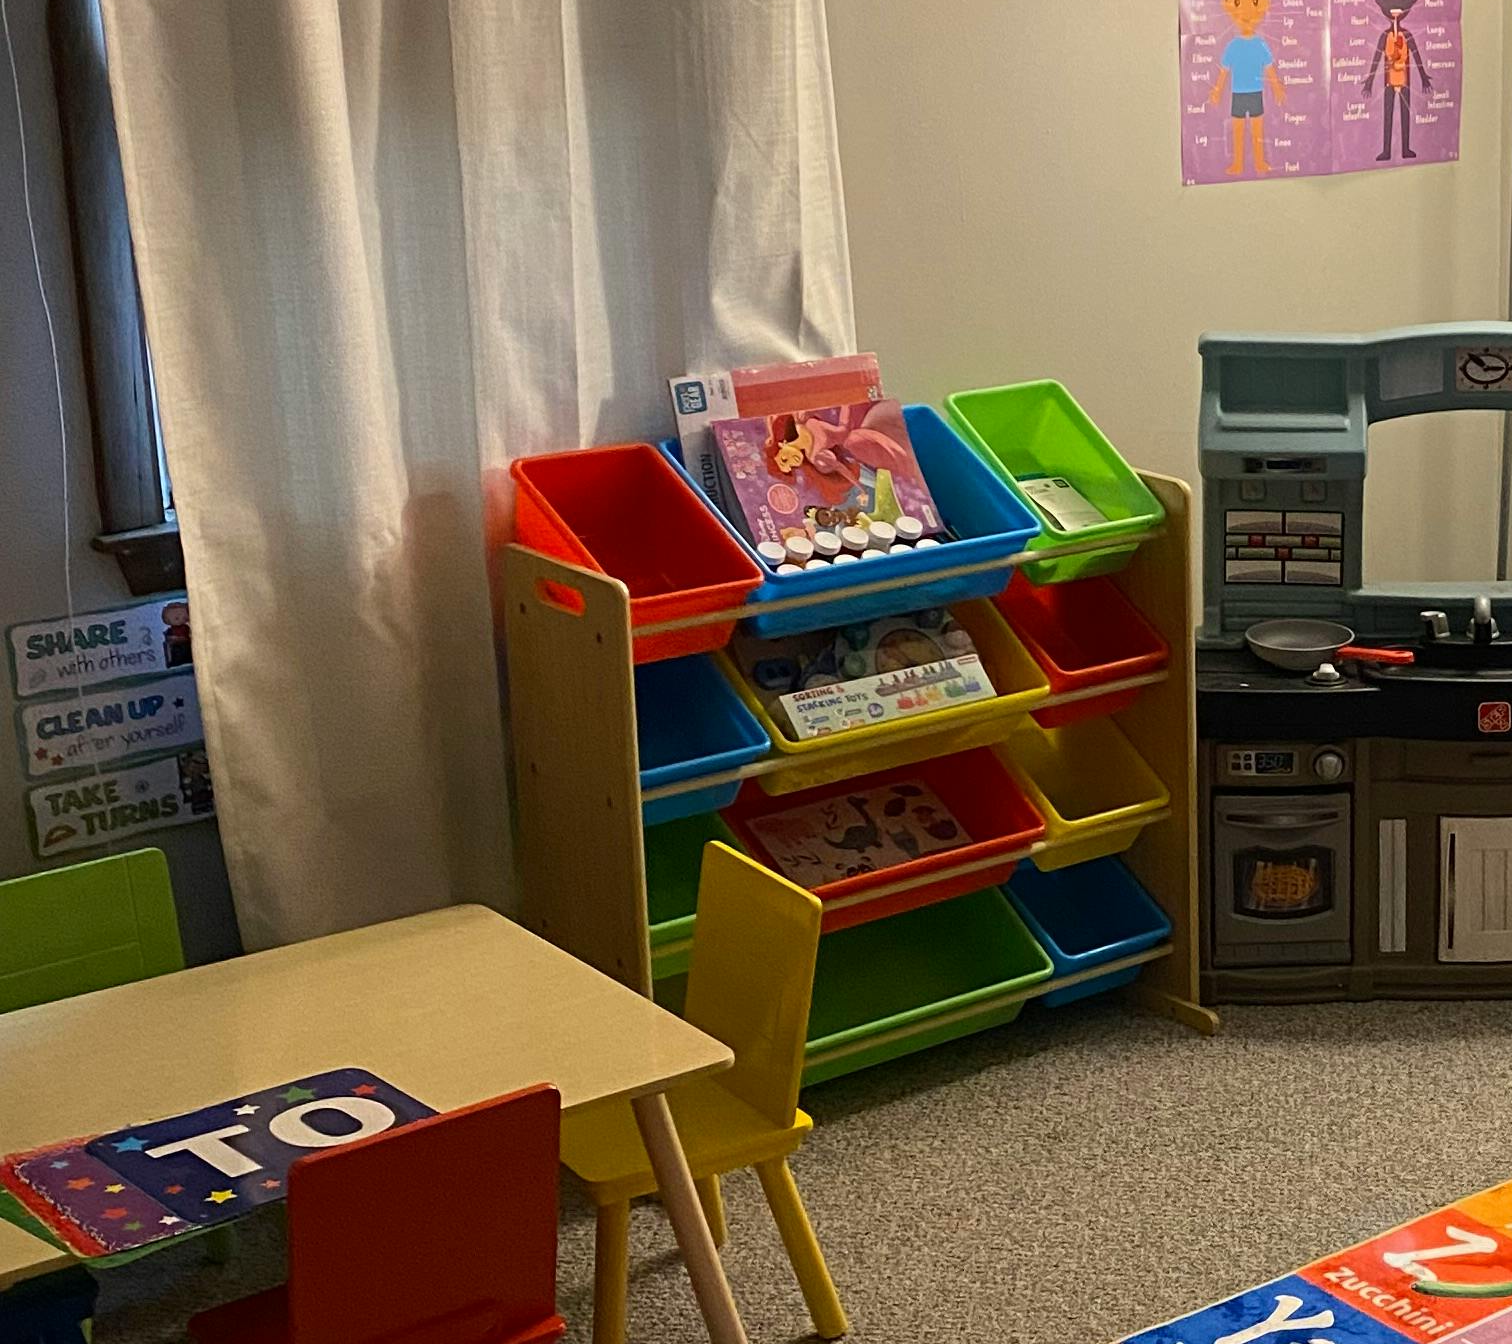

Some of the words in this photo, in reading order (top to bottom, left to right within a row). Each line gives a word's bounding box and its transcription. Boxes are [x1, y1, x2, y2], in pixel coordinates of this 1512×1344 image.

[26, 620, 128, 660] SHARE
[57, 656, 97, 679] with
[99, 650, 156, 672] others
[791, 686, 834, 703] SORTING
[796, 696, 843, 714] STACKING
[845, 692, 869, 704] TOYS
[36, 702, 124, 740] CLEAN
[129, 694, 164, 720] UP
[67, 735, 114, 758] afer
[121, 714, 187, 747] yourself
[44, 779, 121, 817] TAKE
[80, 793, 180, 837] TURNS
[144, 1096, 396, 1178] TO
[1322, 1267, 1455, 1337] Zucchini
